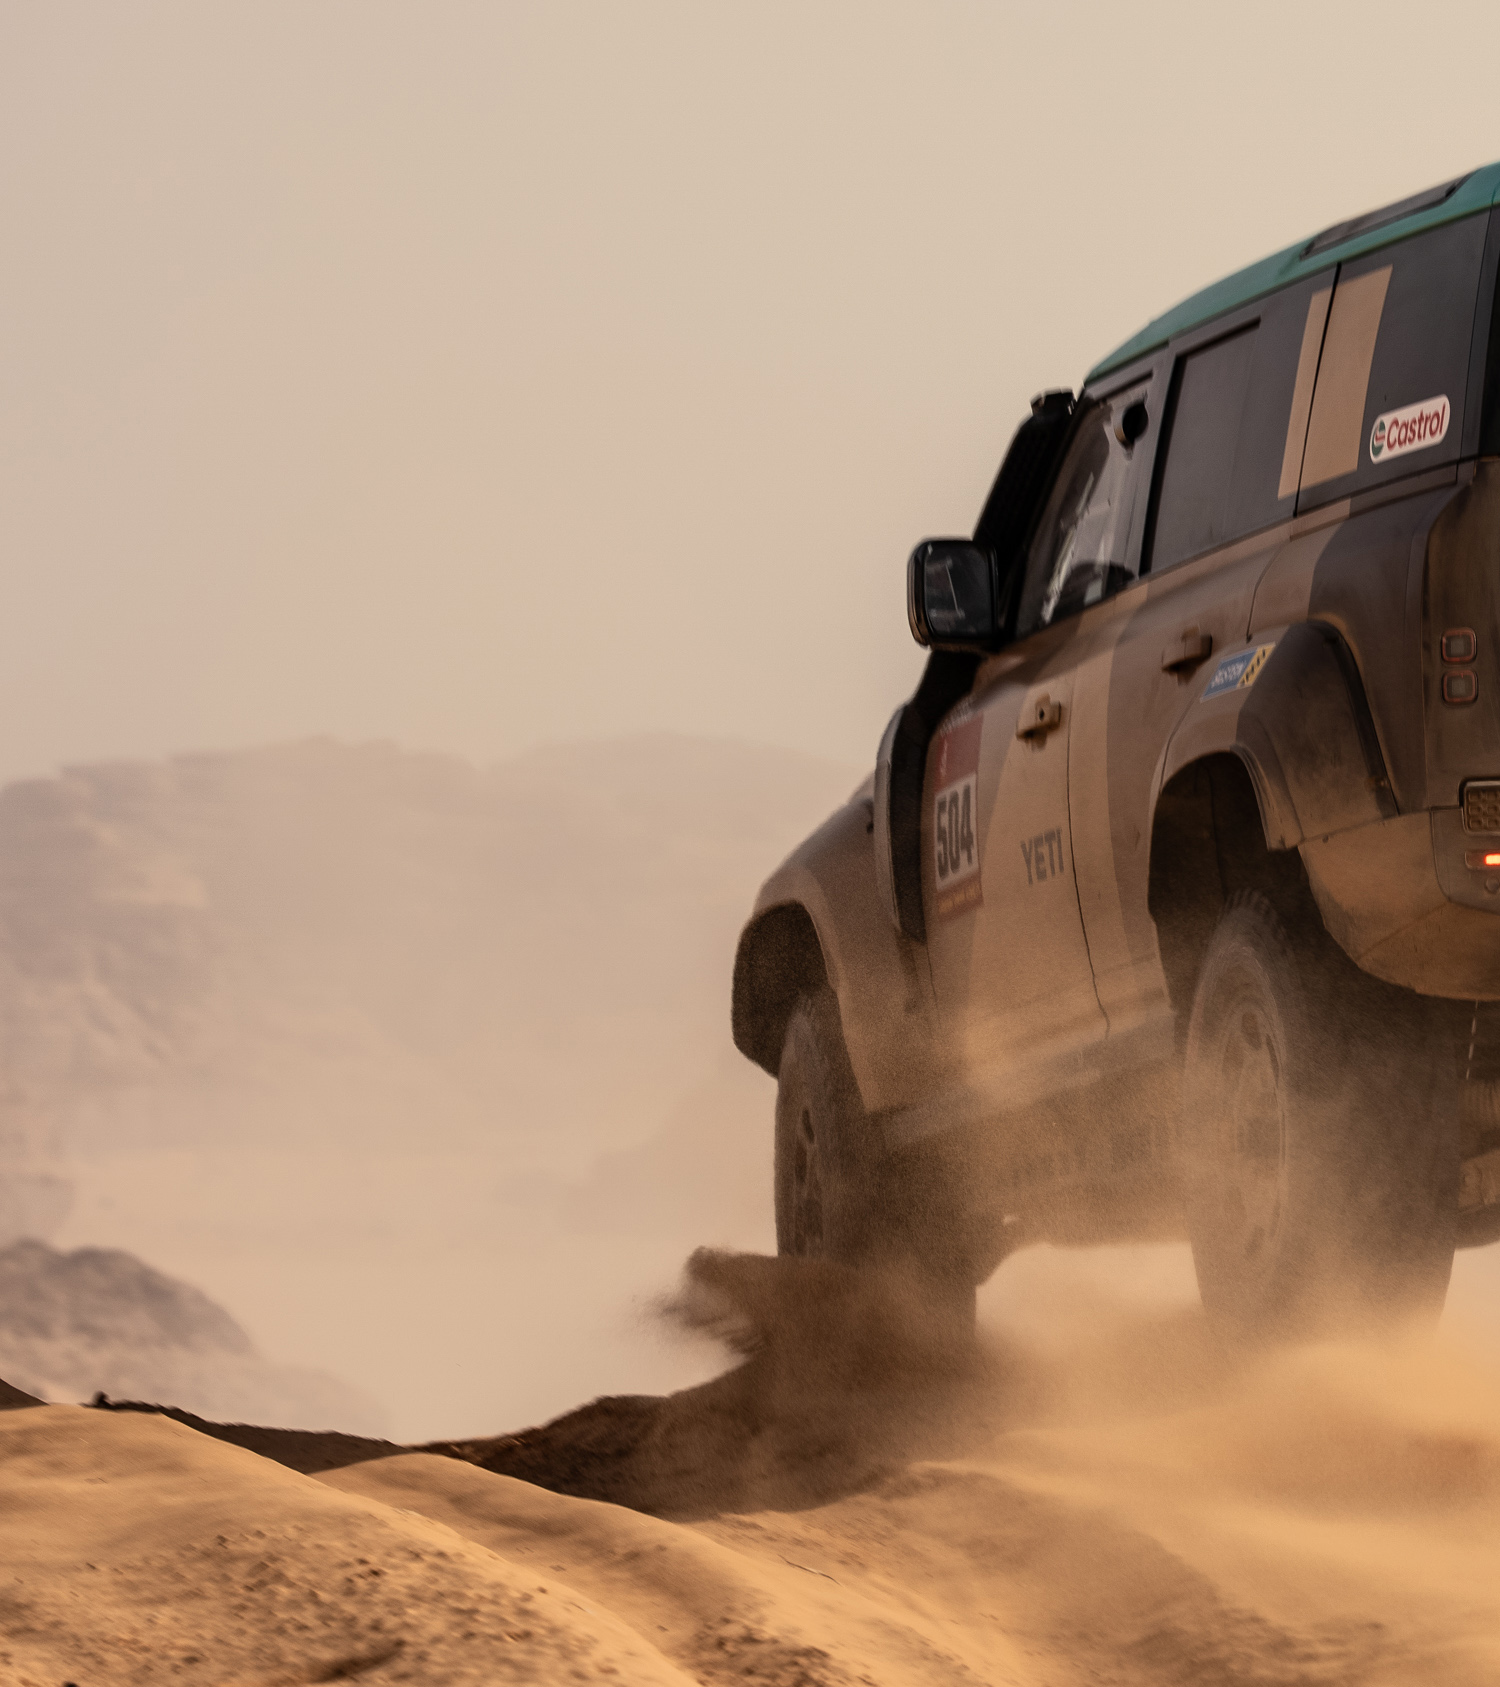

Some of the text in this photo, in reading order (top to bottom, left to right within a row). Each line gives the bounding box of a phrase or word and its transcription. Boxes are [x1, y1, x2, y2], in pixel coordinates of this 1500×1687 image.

[1387, 402, 1446, 452] Castrol
[937, 784, 974, 881] 504
[1020, 828, 1065, 886] YETI
